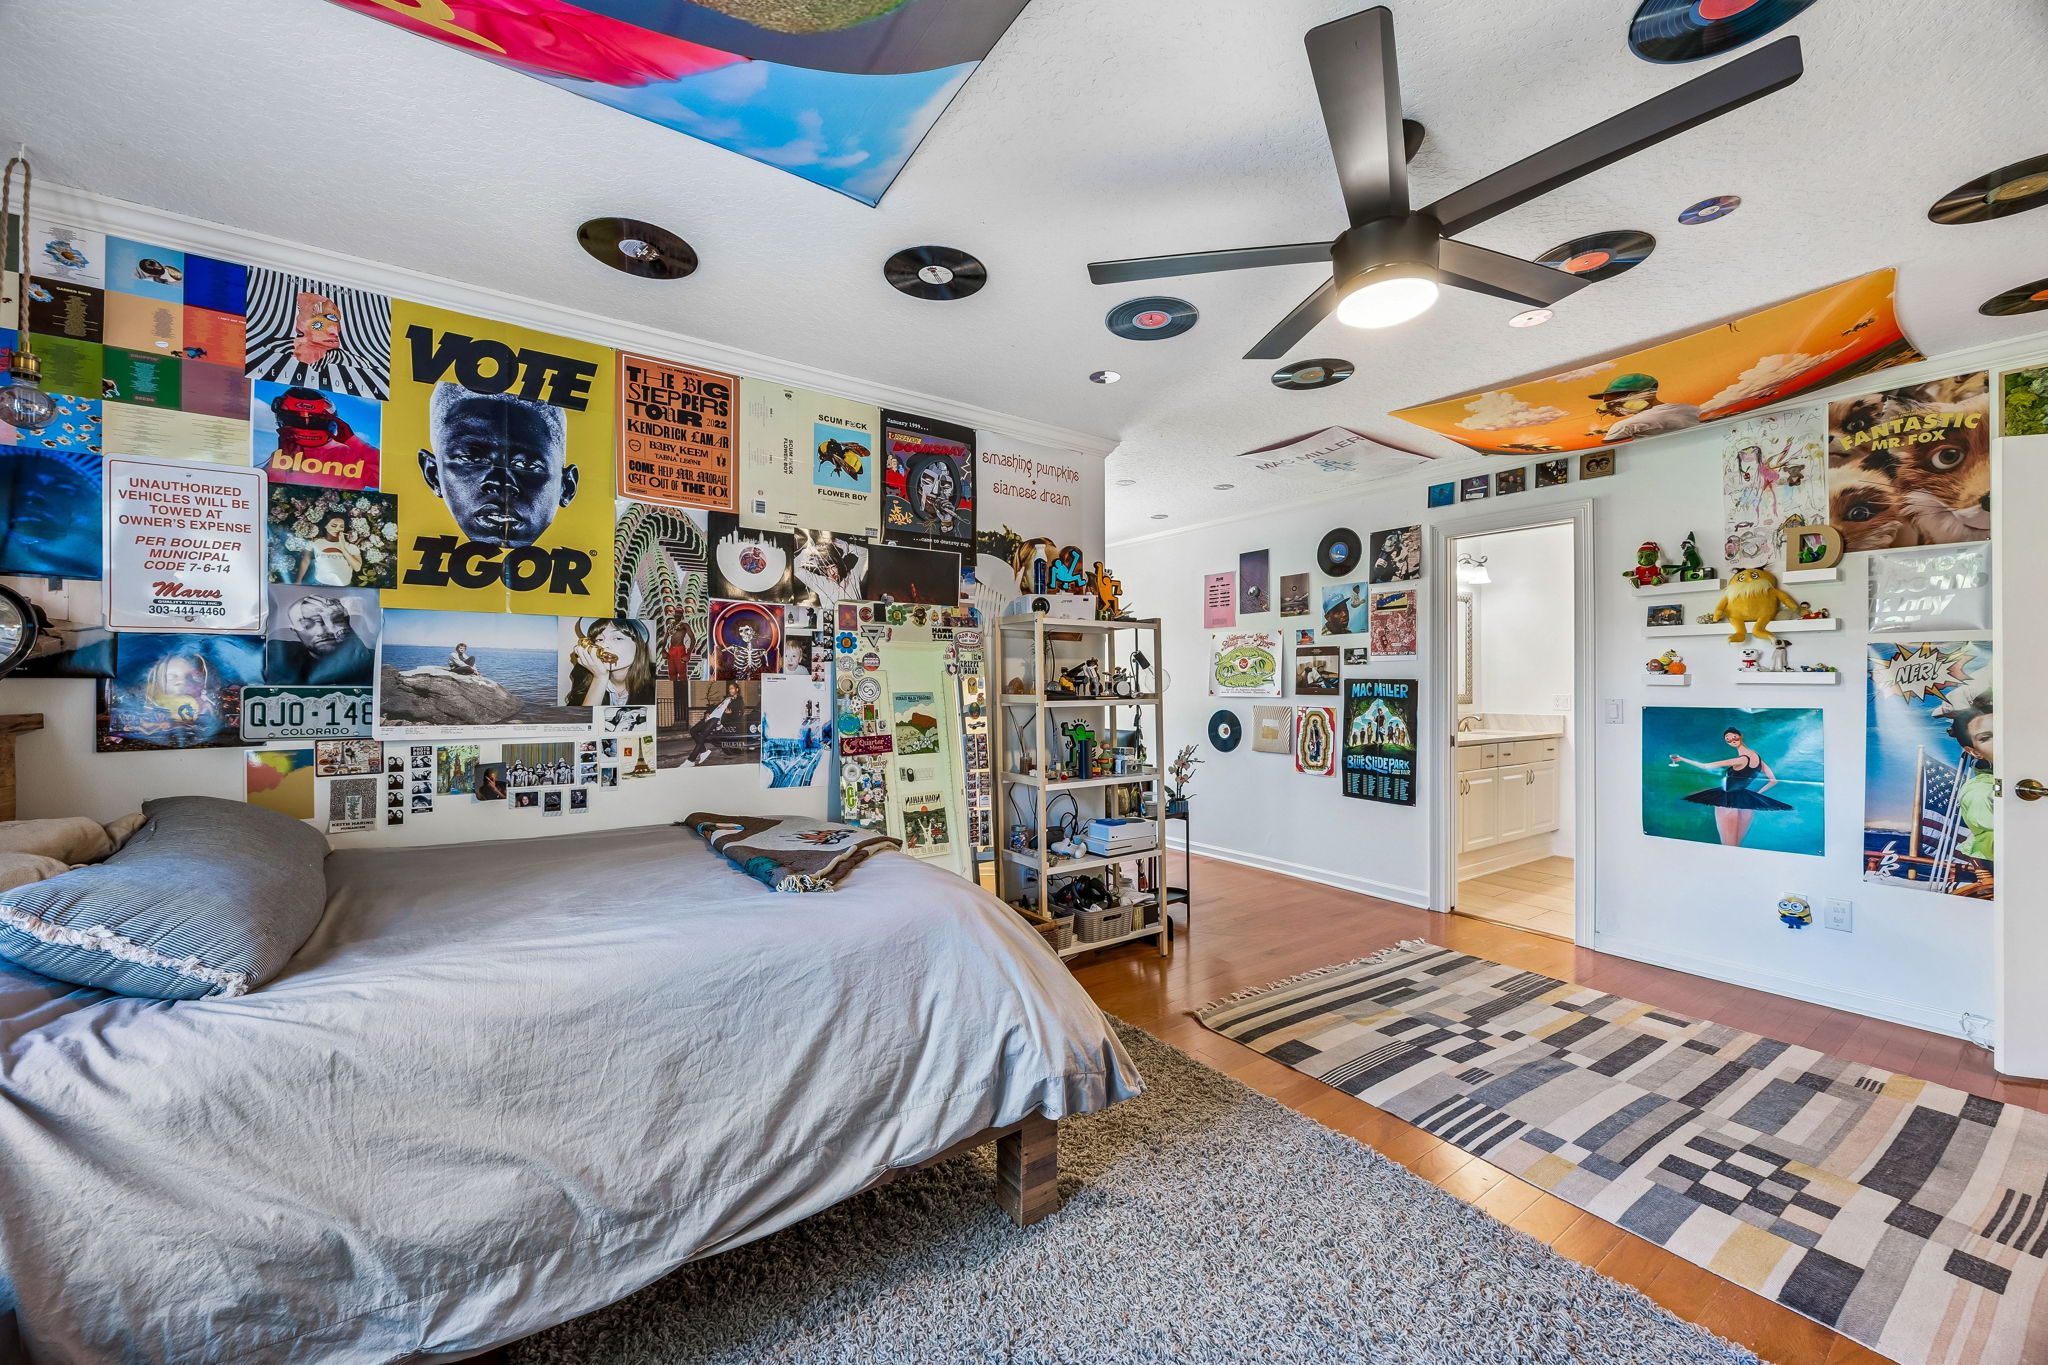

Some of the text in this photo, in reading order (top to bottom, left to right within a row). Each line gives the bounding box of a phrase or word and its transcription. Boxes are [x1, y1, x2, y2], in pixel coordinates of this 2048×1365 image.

[405, 324, 598, 412] VOTE
[626, 365, 730, 400] THE BIG
[628, 382, 728, 416] STEPPERS
[626, 399, 727, 430] TOUR 2022
[818, 414, 843, 426] SCUM
[627, 418, 729, 448] KENDRICK LAMAR
[1840, 412, 1982, 451] FANTASTIC
[1871, 429, 1946, 451] MR. FOX
[679, 445, 708, 458] KEEM
[1255, 458, 1295, 470] MAC
[1296, 436, 1366, 462] MILLER
[272, 449, 364, 479] blond
[628, 460, 655, 475] COME
[658, 464, 674, 478] HELP
[982, 452, 1080, 483] smashing pumpkins
[129, 477, 242, 496] UNAUTHORIZED
[648, 476, 669, 490] OUT
[670, 480, 678, 491] OF
[681, 481, 706, 495] THE
[708, 485, 728, 498] BOX
[818, 488, 850, 500] FLOWER
[852, 491, 868, 502] BOY
[992, 480, 1072, 507] siamese dream
[118, 489, 250, 510] VEHICLES WILL BE
[149, 504, 223, 520] TOWED AT
[118, 515, 252, 534] OWNER'S EXPENSE
[135, 536, 242, 551] PER BOULDER
[1785, 524, 1844, 572] D
[149, 549, 230, 562] MUNICIPAL
[402, 535, 593, 596] IGOR
[144, 561, 231, 574] CODE 7-6-14
[148, 605, 226, 616] 303-444-4460
[1896, 662, 1942, 684] NFR!
[1352, 682, 1372, 698] MAC
[280, 727, 350, 736] COLORADO
[1347, 755, 1365, 768] BLUE
[1389, 758, 1410, 774] PARK
